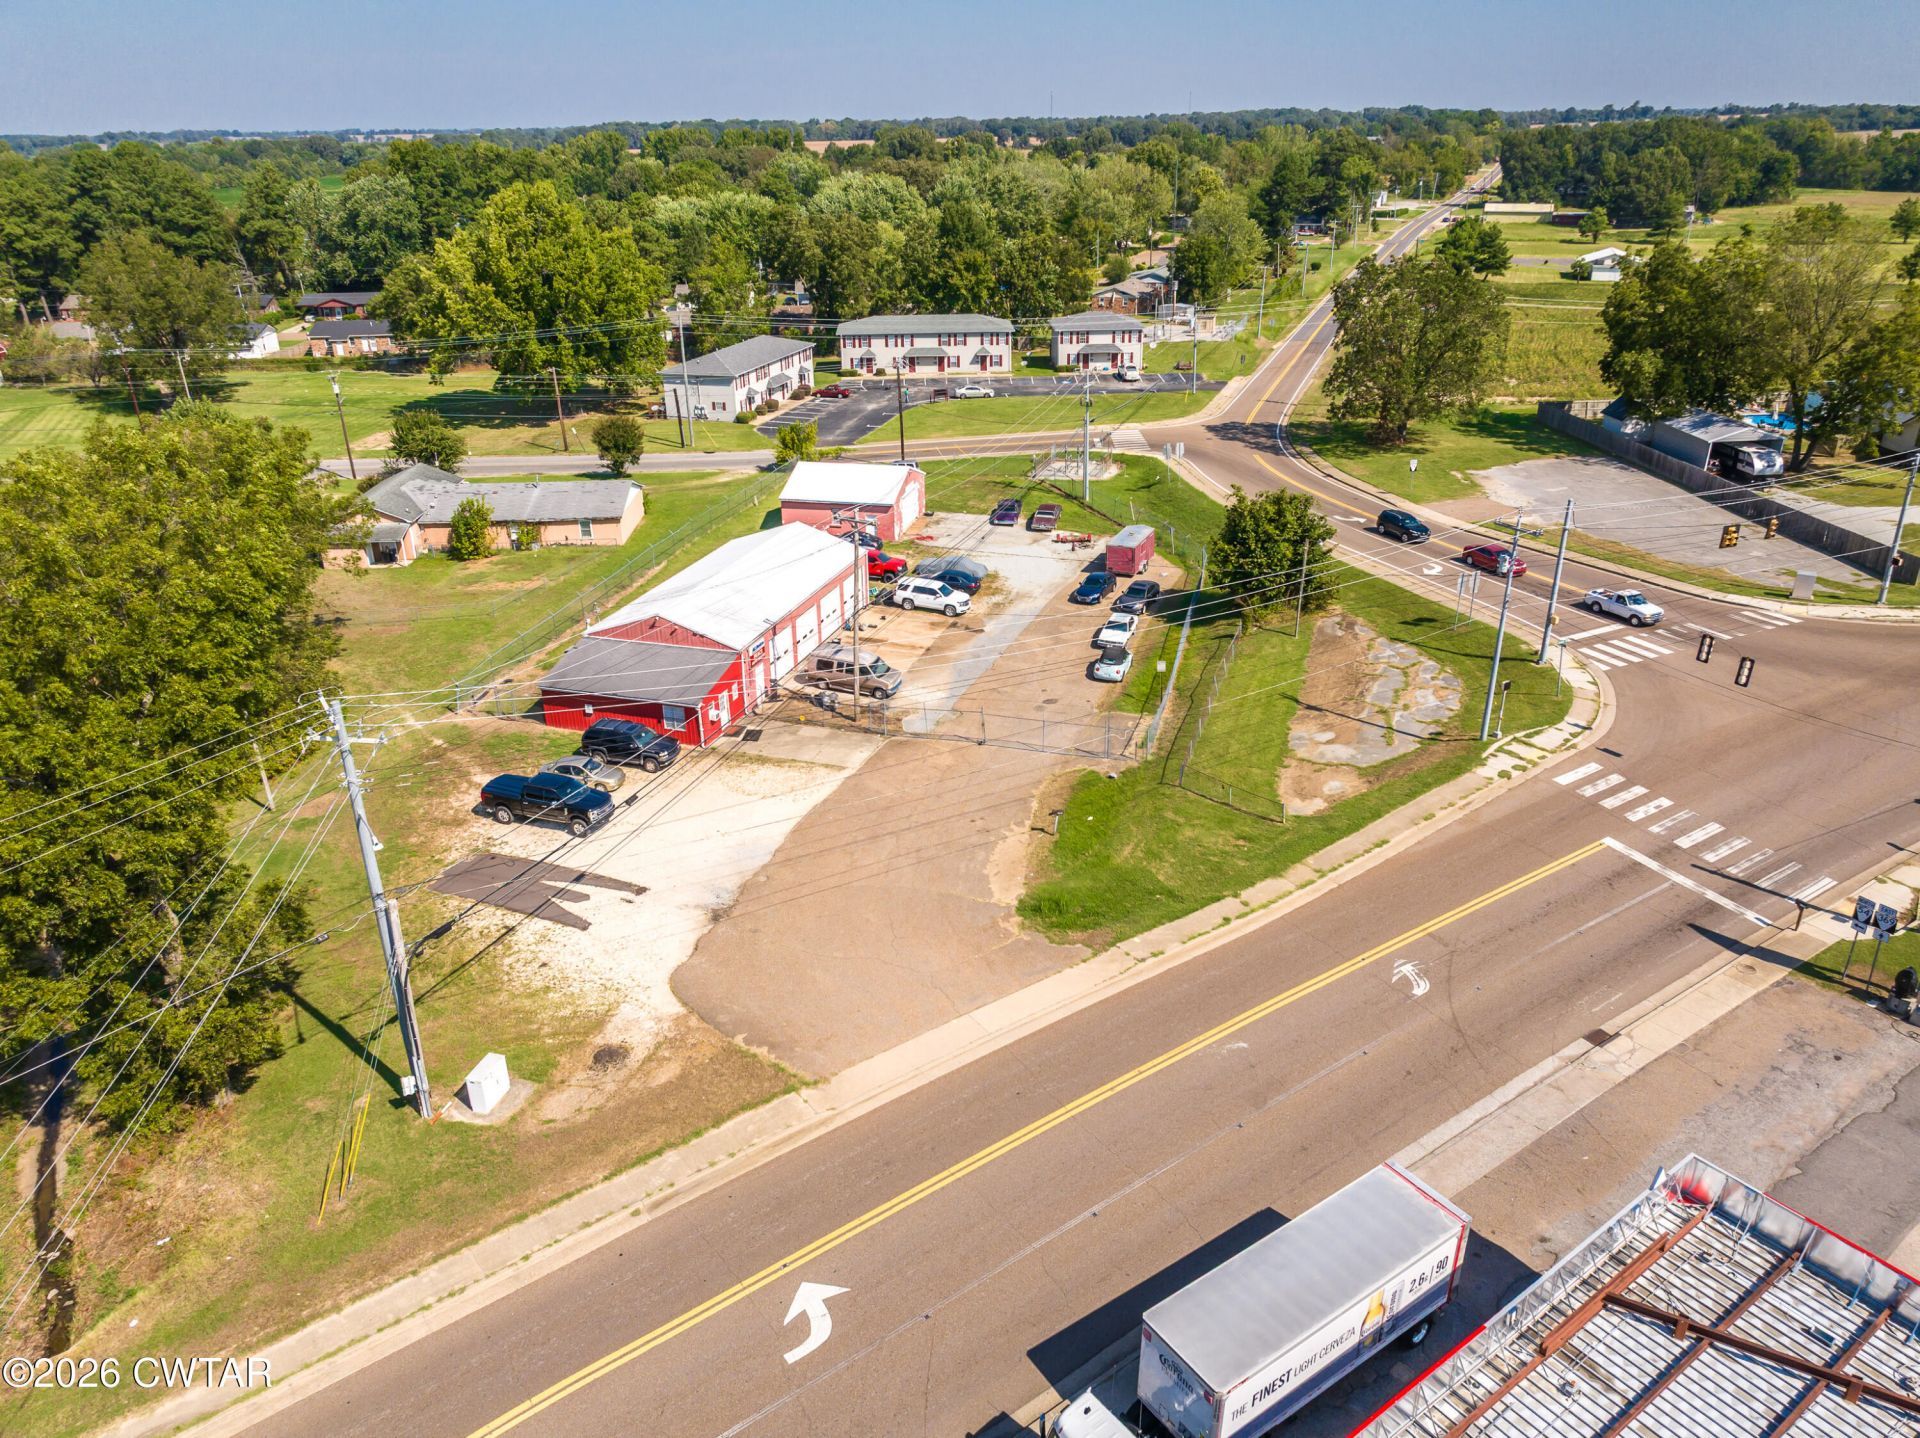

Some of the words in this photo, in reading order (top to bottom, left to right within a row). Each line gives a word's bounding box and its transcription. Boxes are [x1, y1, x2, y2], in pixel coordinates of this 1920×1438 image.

[1435, 1256, 1449, 1274] 90
[1159, 1354, 1194, 1394] Corona
[1231, 1402, 1249, 1421] THE
[1251, 1368, 1292, 1407] FINEST
[1293, 1353, 1318, 1377] LIGHT
[1318, 1326, 1356, 1359] CERVEZA
